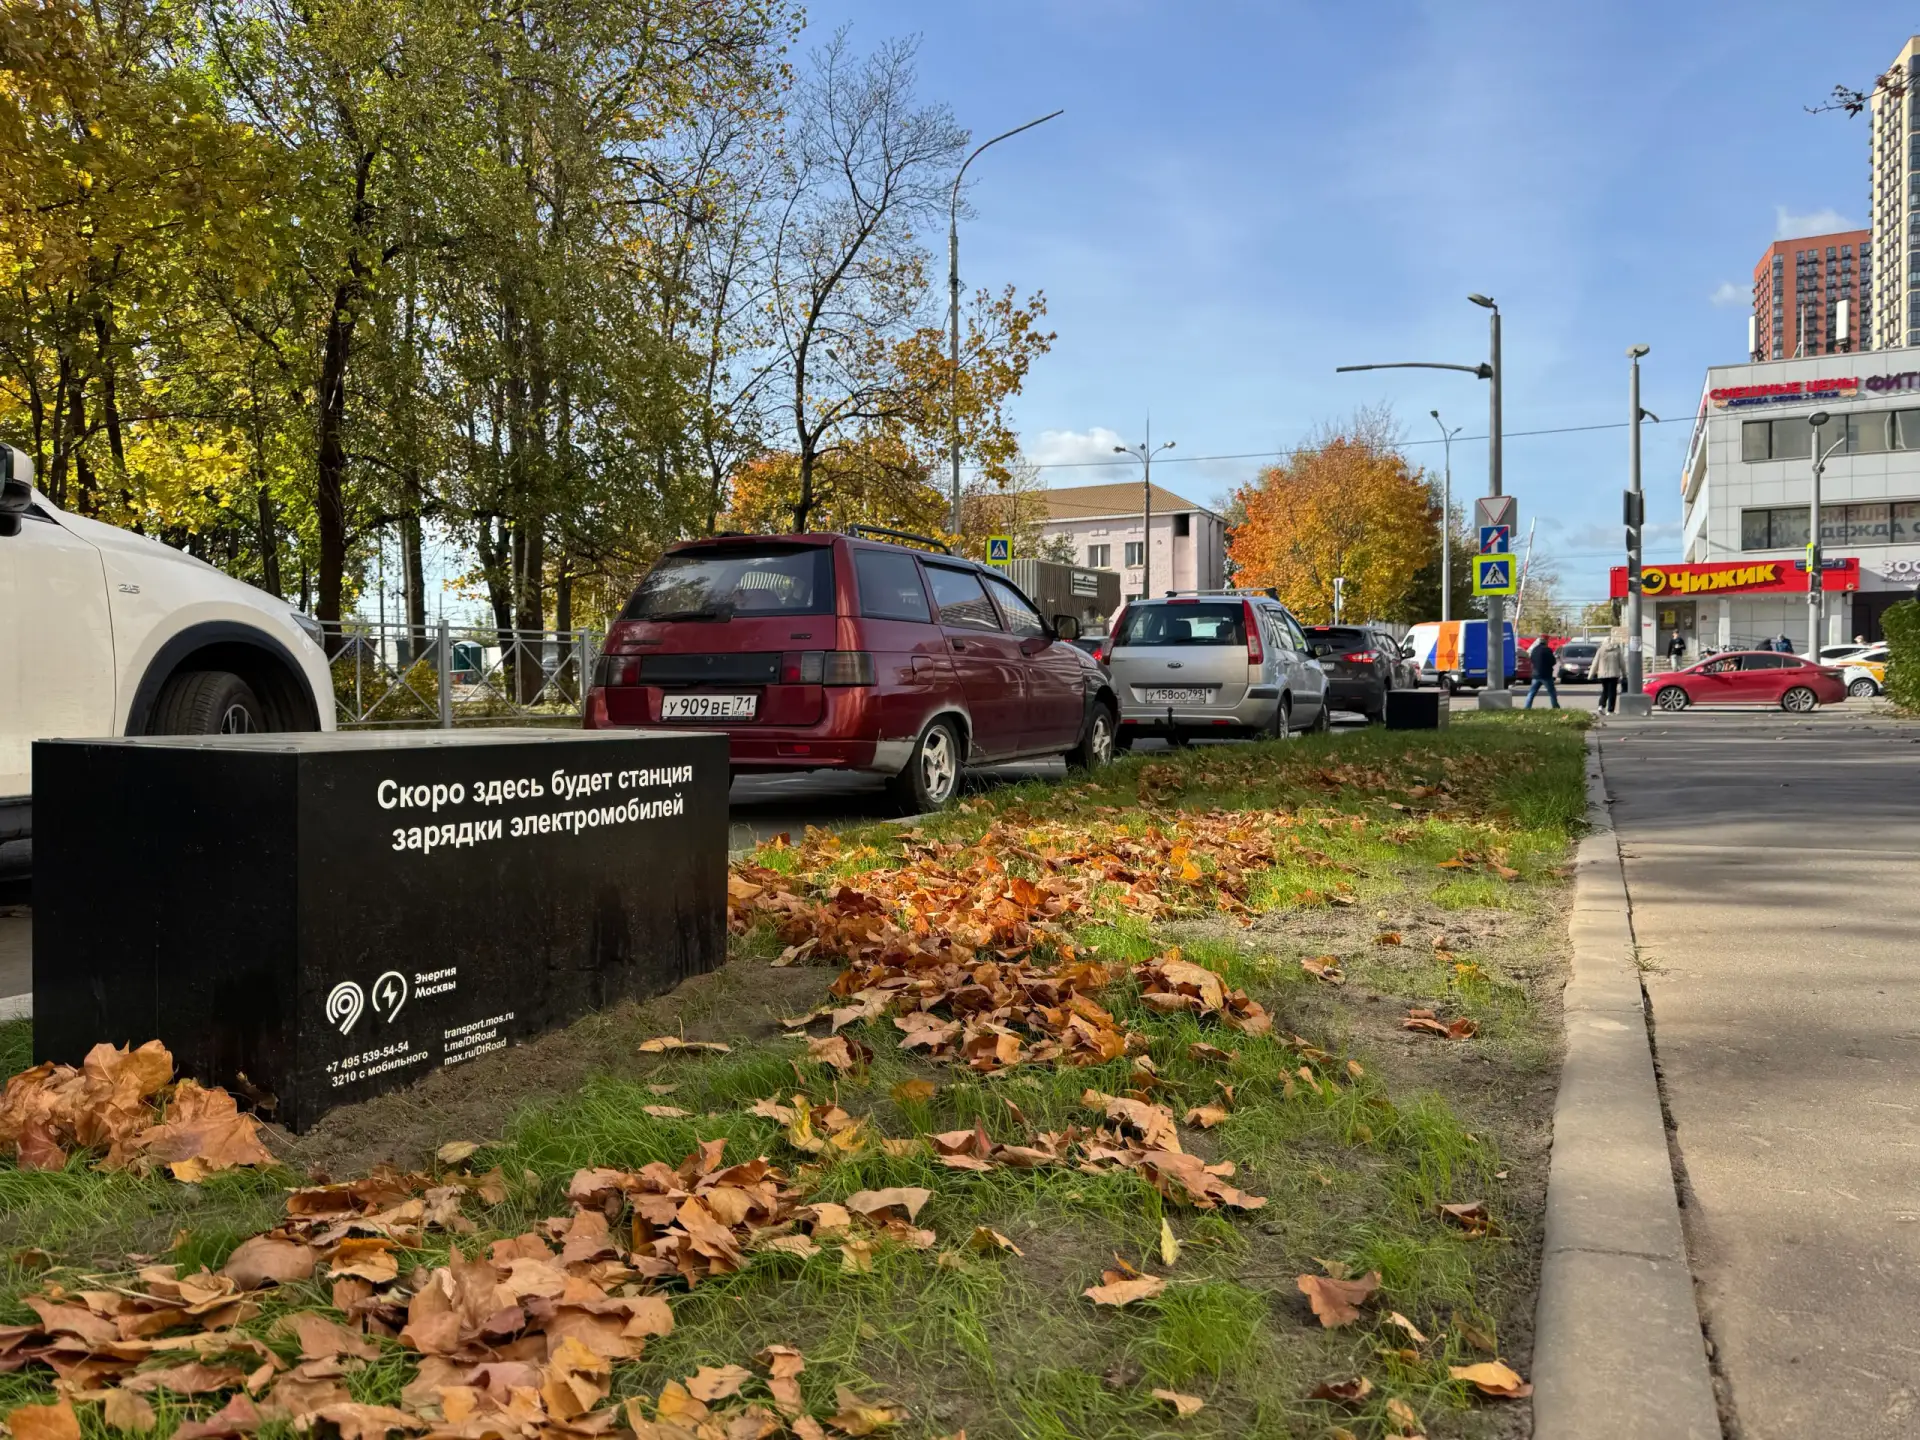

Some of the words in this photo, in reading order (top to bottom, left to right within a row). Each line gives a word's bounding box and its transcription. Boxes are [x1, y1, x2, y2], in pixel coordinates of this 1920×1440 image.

[1709, 381, 1801, 401] СМЕШНЫЕ
[1806, 377, 1858, 392] ЦЕНЫ
[1866, 371, 1920, 391] ФИТ
[736, 697, 751, 711] 71
[377, 779, 465, 812] Скоро
[472, 777, 545, 805] здесь
[551, 769, 613, 801] будет
[618, 765, 693, 788] станция
[391, 818, 502, 854] зарядки
[510, 792, 684, 835] электромобилей
[414, 967, 457, 985] Энергия
[414, 981, 457, 998] Москвы
[444, 1012, 515, 1039] transport.mos.ru
[444, 1028, 497, 1053] t.me/DtRoad
[444, 1037, 507, 1066] max.ru/DtRoad
[325, 1061, 339, 1073] +7
[341, 1056, 360, 1069] 495
[362, 1041, 409, 1064] 539-54-54
[332, 1073, 357, 1087] 3210
[359, 1070, 366, 1079] с
[367, 1051, 429, 1076] мобильного
